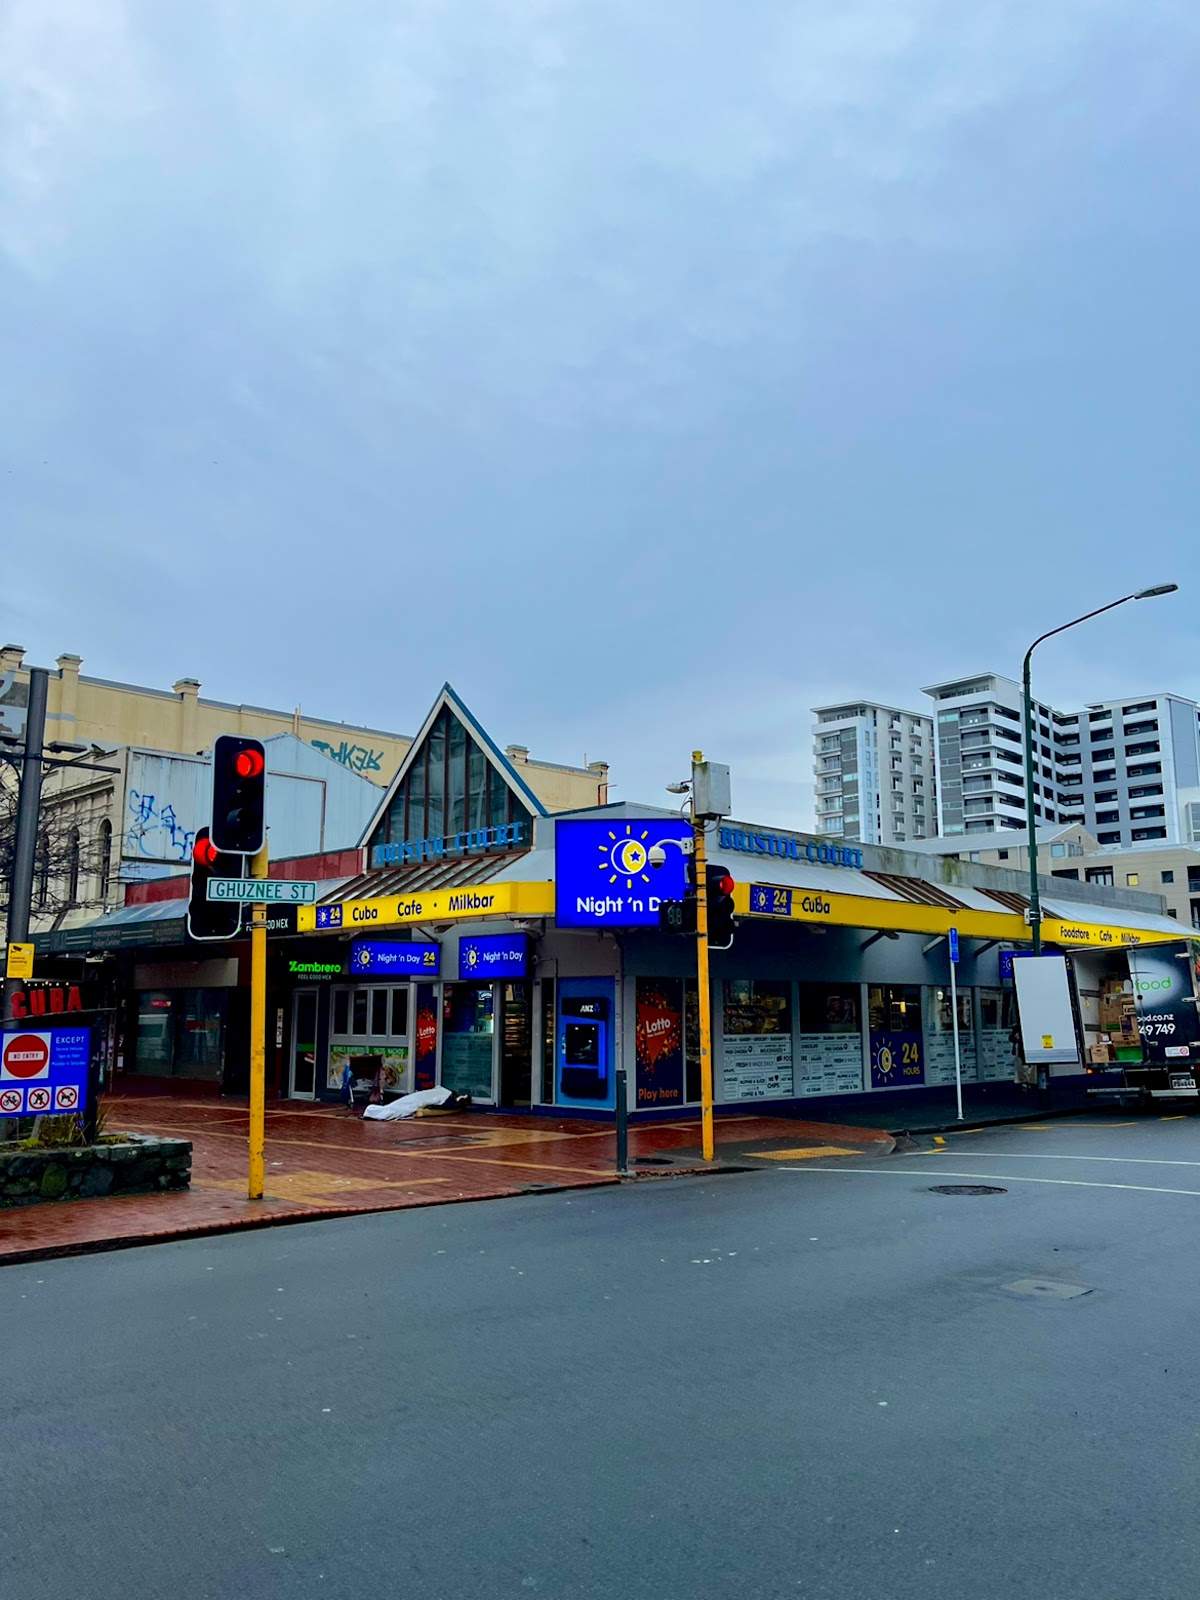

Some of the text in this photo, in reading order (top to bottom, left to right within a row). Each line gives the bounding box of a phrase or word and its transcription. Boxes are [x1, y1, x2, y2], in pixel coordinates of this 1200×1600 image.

[216, 882, 308, 899] GHUZNEE ST
[773, 890, 787, 906] 24
[352, 893, 494, 921] Cuba Cafe Milkbar
[576, 896, 623, 916] Night
[801, 896, 830, 914] Cuba
[330, 907, 340, 919] 24
[276, 919, 288, 928] MEX
[1060, 926, 1089, 940] Foodstore
[1099, 929, 1112, 942] Cafe
[377, 953, 397, 963] Night
[406, 954, 420, 964] Day
[423, 952, 435, 961] 24
[483, 952, 500, 963] Night
[509, 950, 523, 962] Day
[289, 961, 341, 972] Zambrero
[1135, 976, 1172, 991] food
[419, 1026, 435, 1036] Lotto
[646, 1018, 670, 1033] Lotto
[1155, 1023, 1175, 1035] 749
[901, 1042, 919, 1064] 24
[903, 1067, 920, 1076] HOURS
[638, 1088, 679, 1101] Play here
